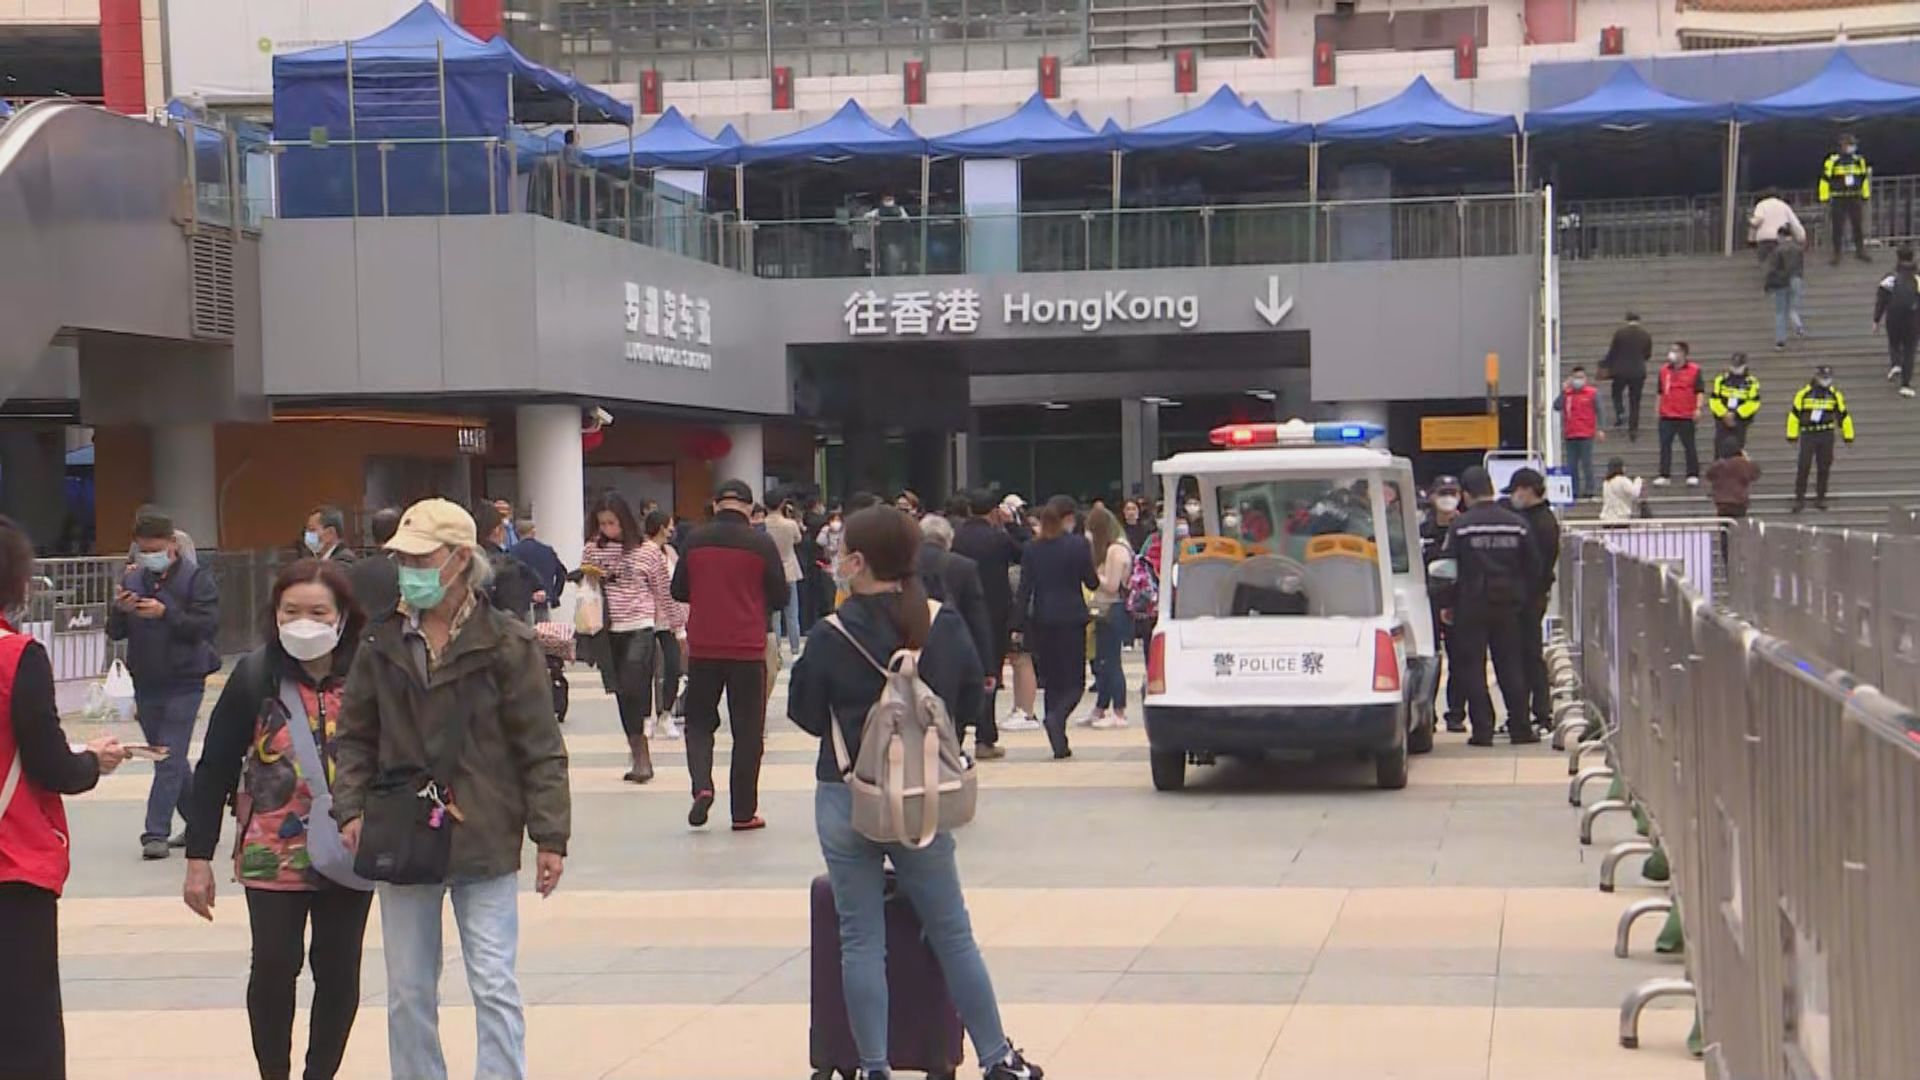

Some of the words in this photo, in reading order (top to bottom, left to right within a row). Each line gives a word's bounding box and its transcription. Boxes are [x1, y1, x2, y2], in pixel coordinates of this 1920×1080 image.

[844, 289, 980, 335] 往香港
[1003, 290, 1199, 331] HongKong
[1213, 653, 1235, 676] 警
[1239, 658, 1297, 671] POLICE
[1302, 652, 1323, 675] 察
